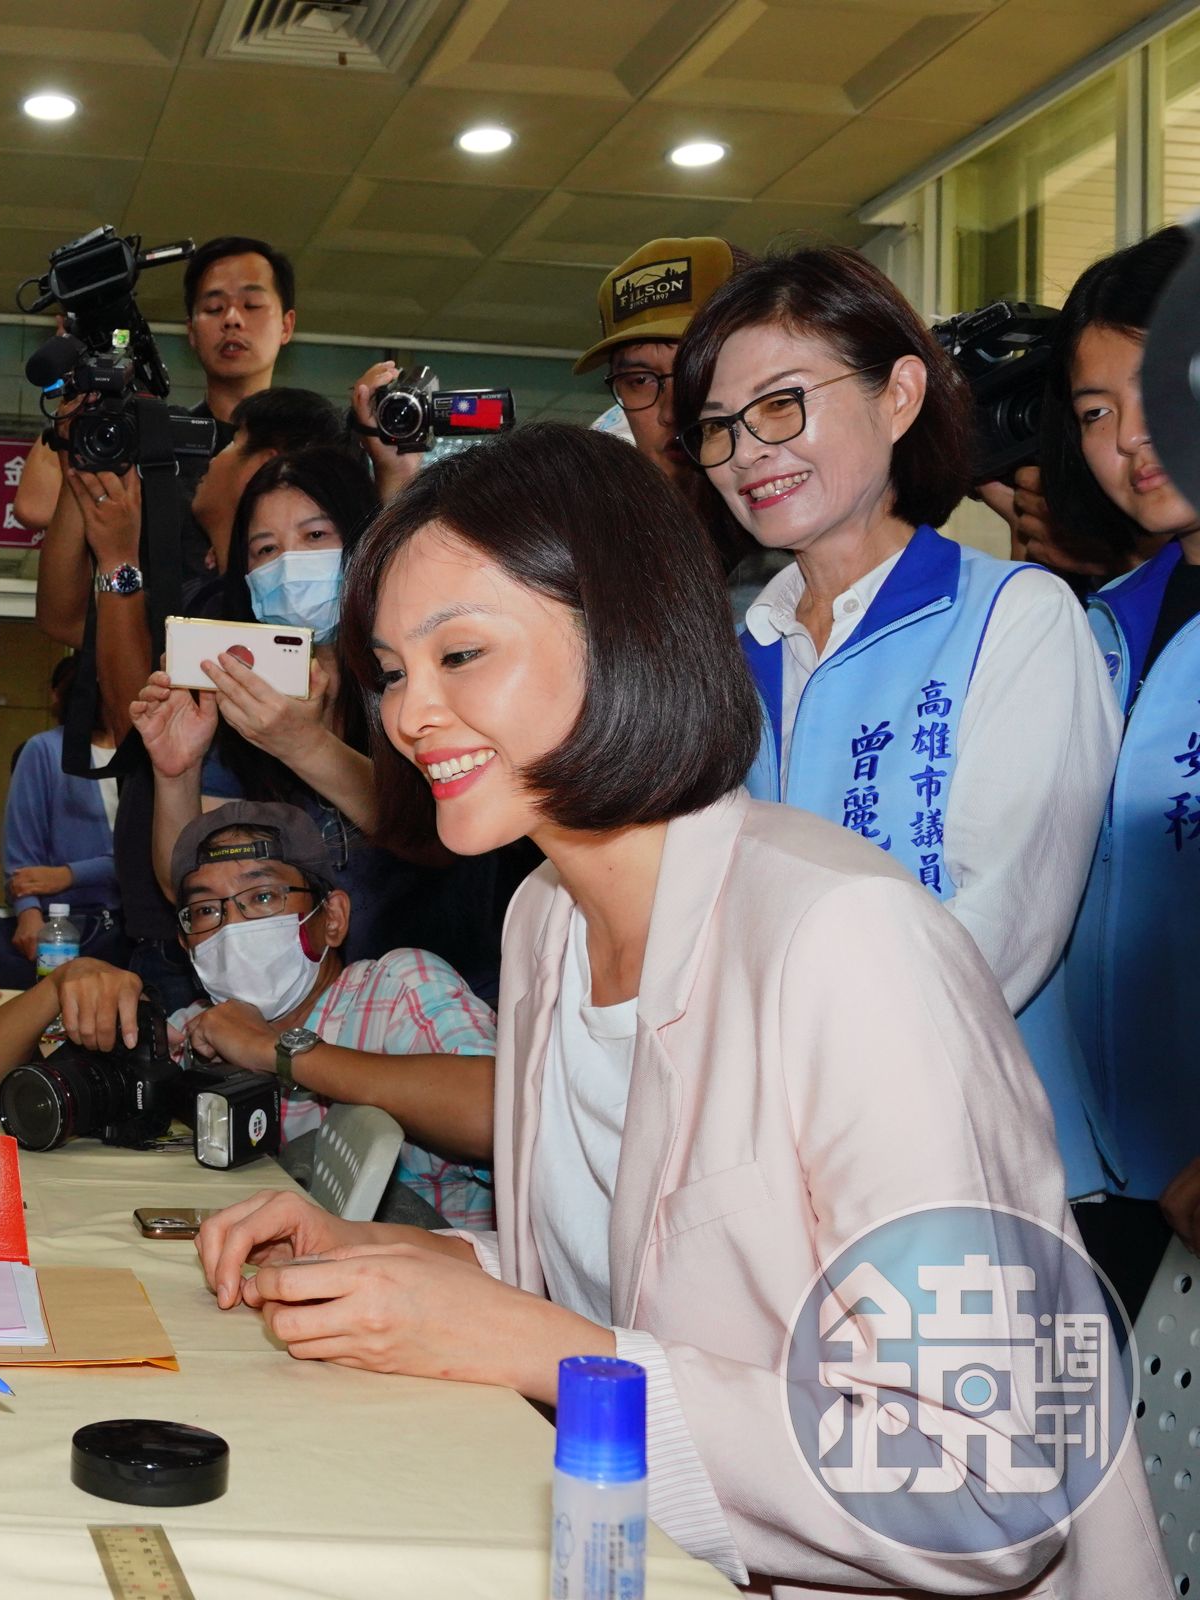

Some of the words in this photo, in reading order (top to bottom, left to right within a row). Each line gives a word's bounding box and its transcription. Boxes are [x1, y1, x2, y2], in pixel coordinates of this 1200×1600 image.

[619, 279, 684, 308] FILSON
[629, 297, 649, 310] SINCE
[909, 679, 953, 894] 高雄市議員
[136, 1081, 144, 1110] Canon
